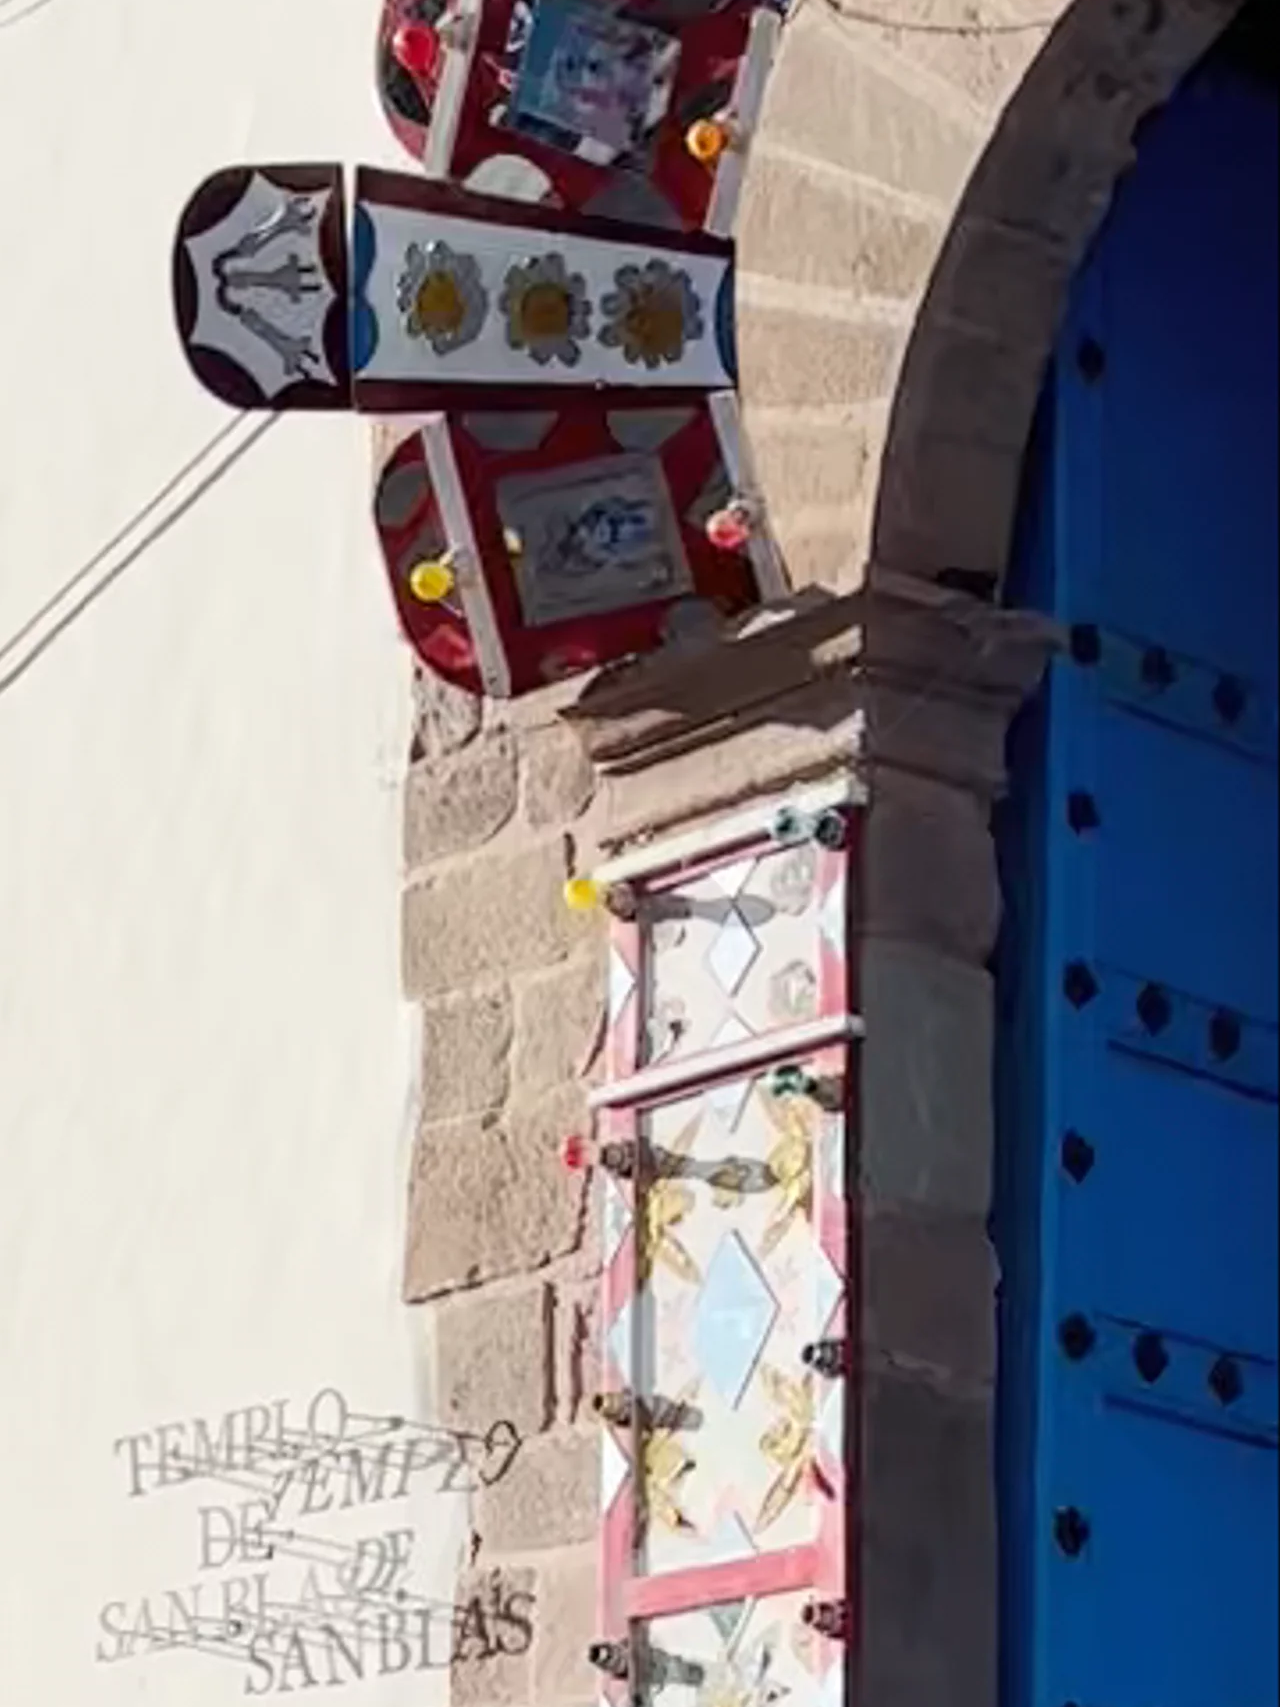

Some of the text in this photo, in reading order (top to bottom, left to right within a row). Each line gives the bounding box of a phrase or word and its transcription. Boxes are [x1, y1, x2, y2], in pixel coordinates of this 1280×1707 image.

[114, 1387, 348, 1497] TEMPLO
[197, 1499, 276, 1571] DE
[95, 1584, 204, 1663] SAN
